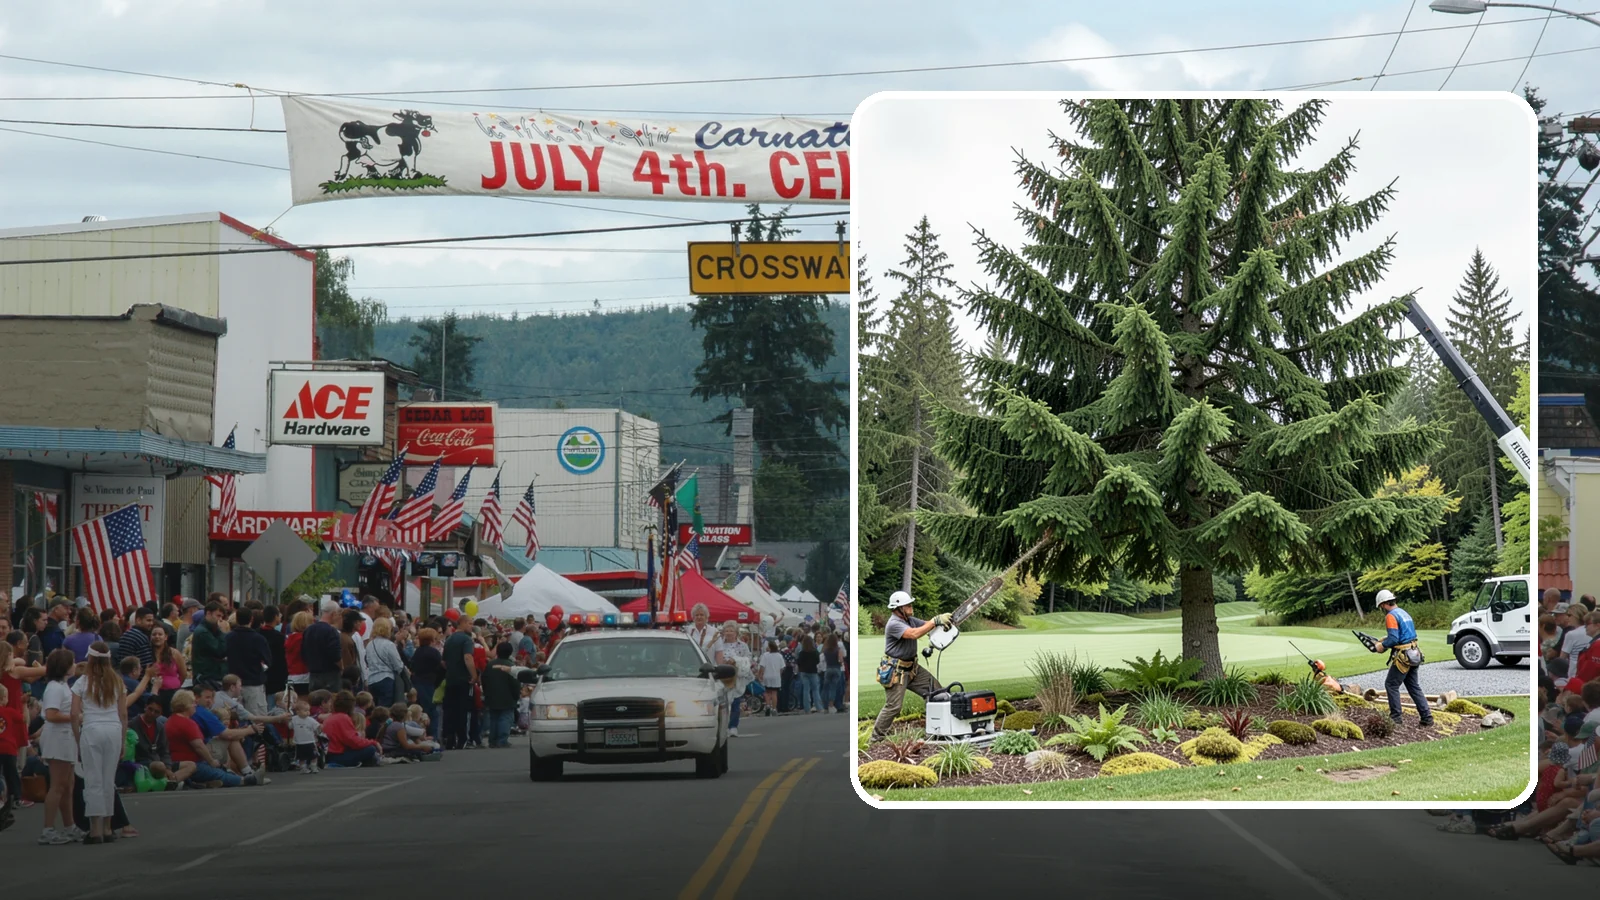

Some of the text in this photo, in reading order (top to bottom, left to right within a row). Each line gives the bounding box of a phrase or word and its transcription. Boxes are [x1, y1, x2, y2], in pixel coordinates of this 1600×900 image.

[481, 140, 605, 192] JULY
[632, 150, 747, 198] 4th.
[696, 254, 850, 280] CROSSWA
[282, 379, 374, 420] ACE
[406, 409, 452, 422] CEDAR
[283, 421, 371, 437] Hardware
[416, 428, 477, 447] Coca-Cola
[83, 484, 155, 495] St. Vincent de Paul
[688, 526, 741, 535] CRNATION
[699, 535, 730, 543] GLASS
